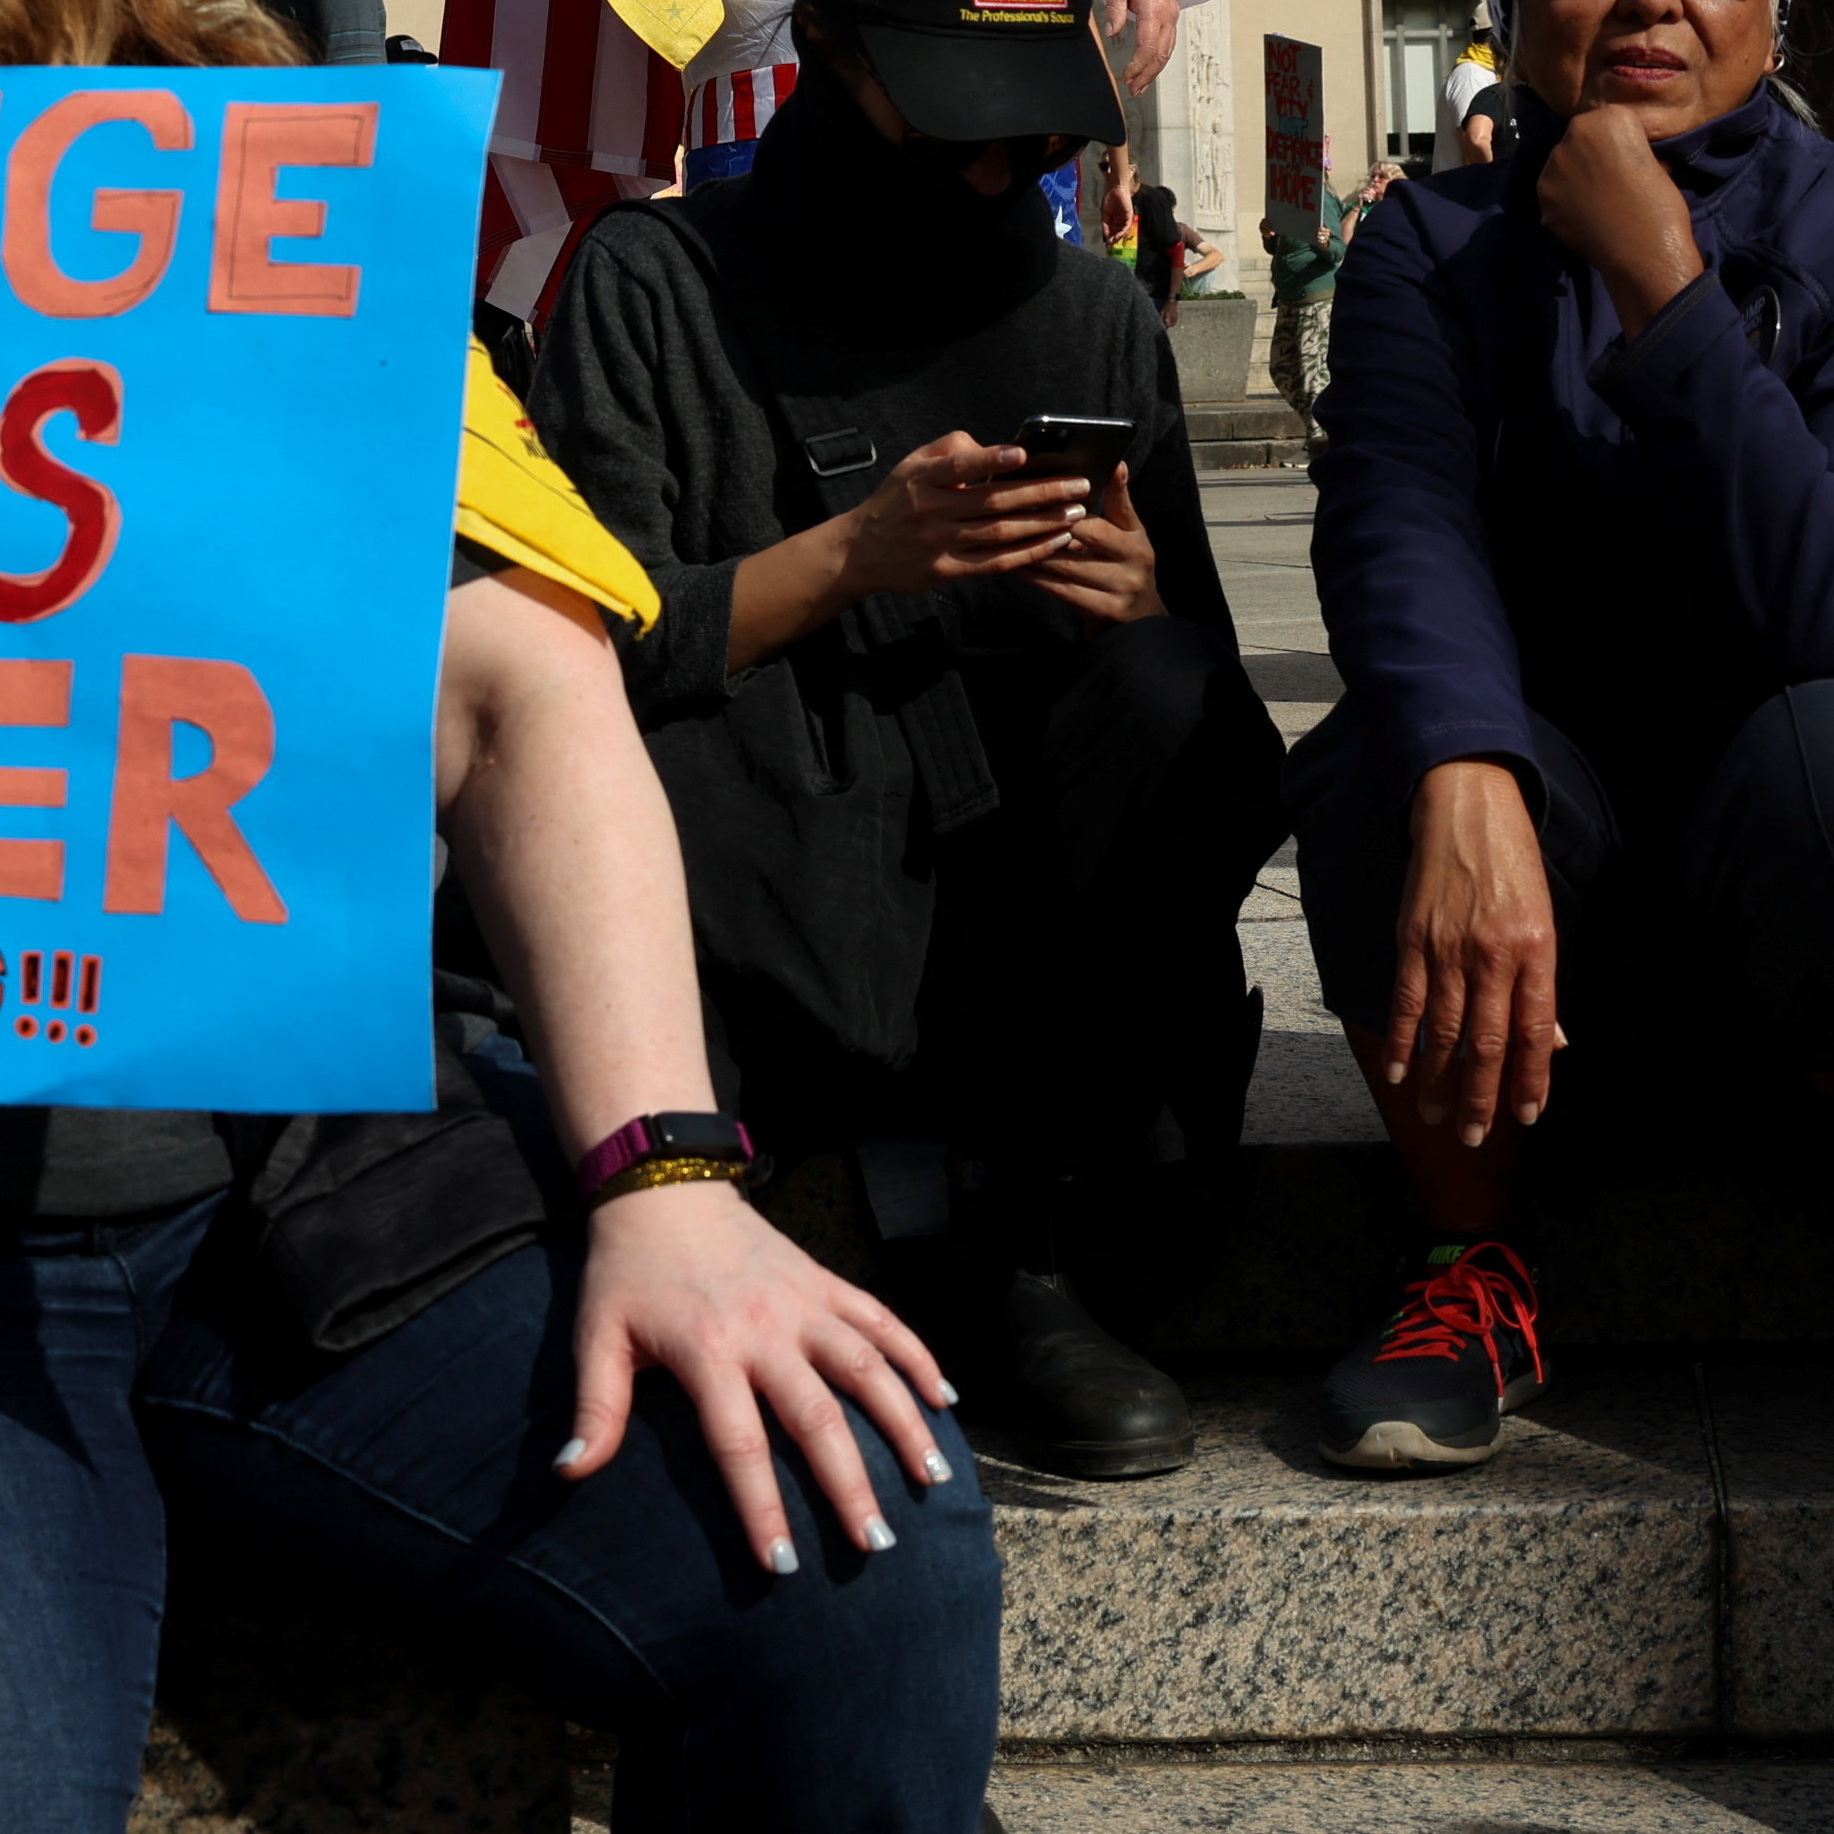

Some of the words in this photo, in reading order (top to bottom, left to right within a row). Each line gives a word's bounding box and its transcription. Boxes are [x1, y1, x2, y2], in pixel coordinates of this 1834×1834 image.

[959, 9, 980, 22] The
[1268, 40, 1303, 74] NOT
[1267, 71, 1301, 98] FEAR
[1270, 163, 1316, 212] HOPE
